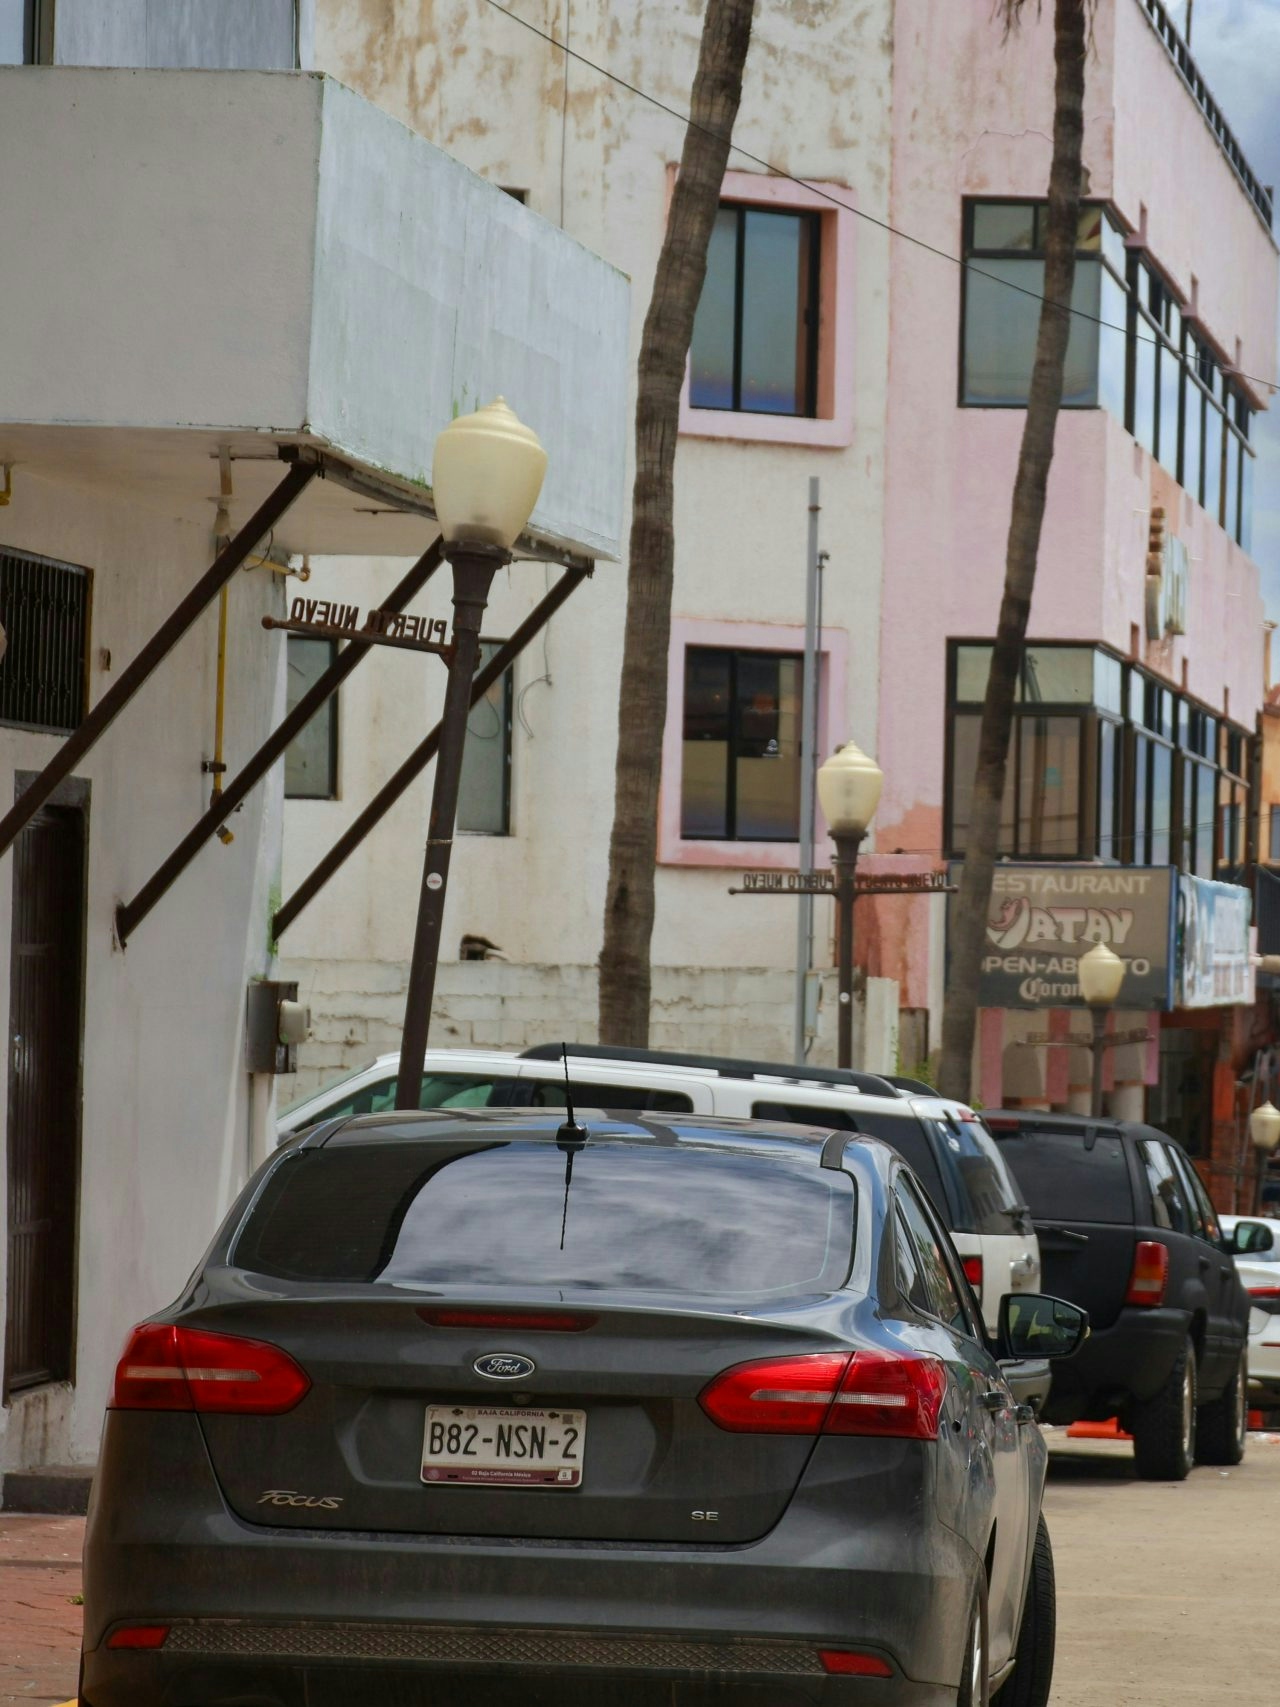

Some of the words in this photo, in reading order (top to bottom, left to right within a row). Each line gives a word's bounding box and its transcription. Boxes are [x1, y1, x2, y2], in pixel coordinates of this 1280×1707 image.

[992, 873, 1152, 895] ESTAURANT
[1018, 976, 1081, 1003] Coron
[487, 1358, 521, 1373] Ford
[499, 1410, 545, 1418] CALIFORNIA
[429, 1422, 579, 1459] B82-NSN-2
[691, 1510, 719, 1521] SE
